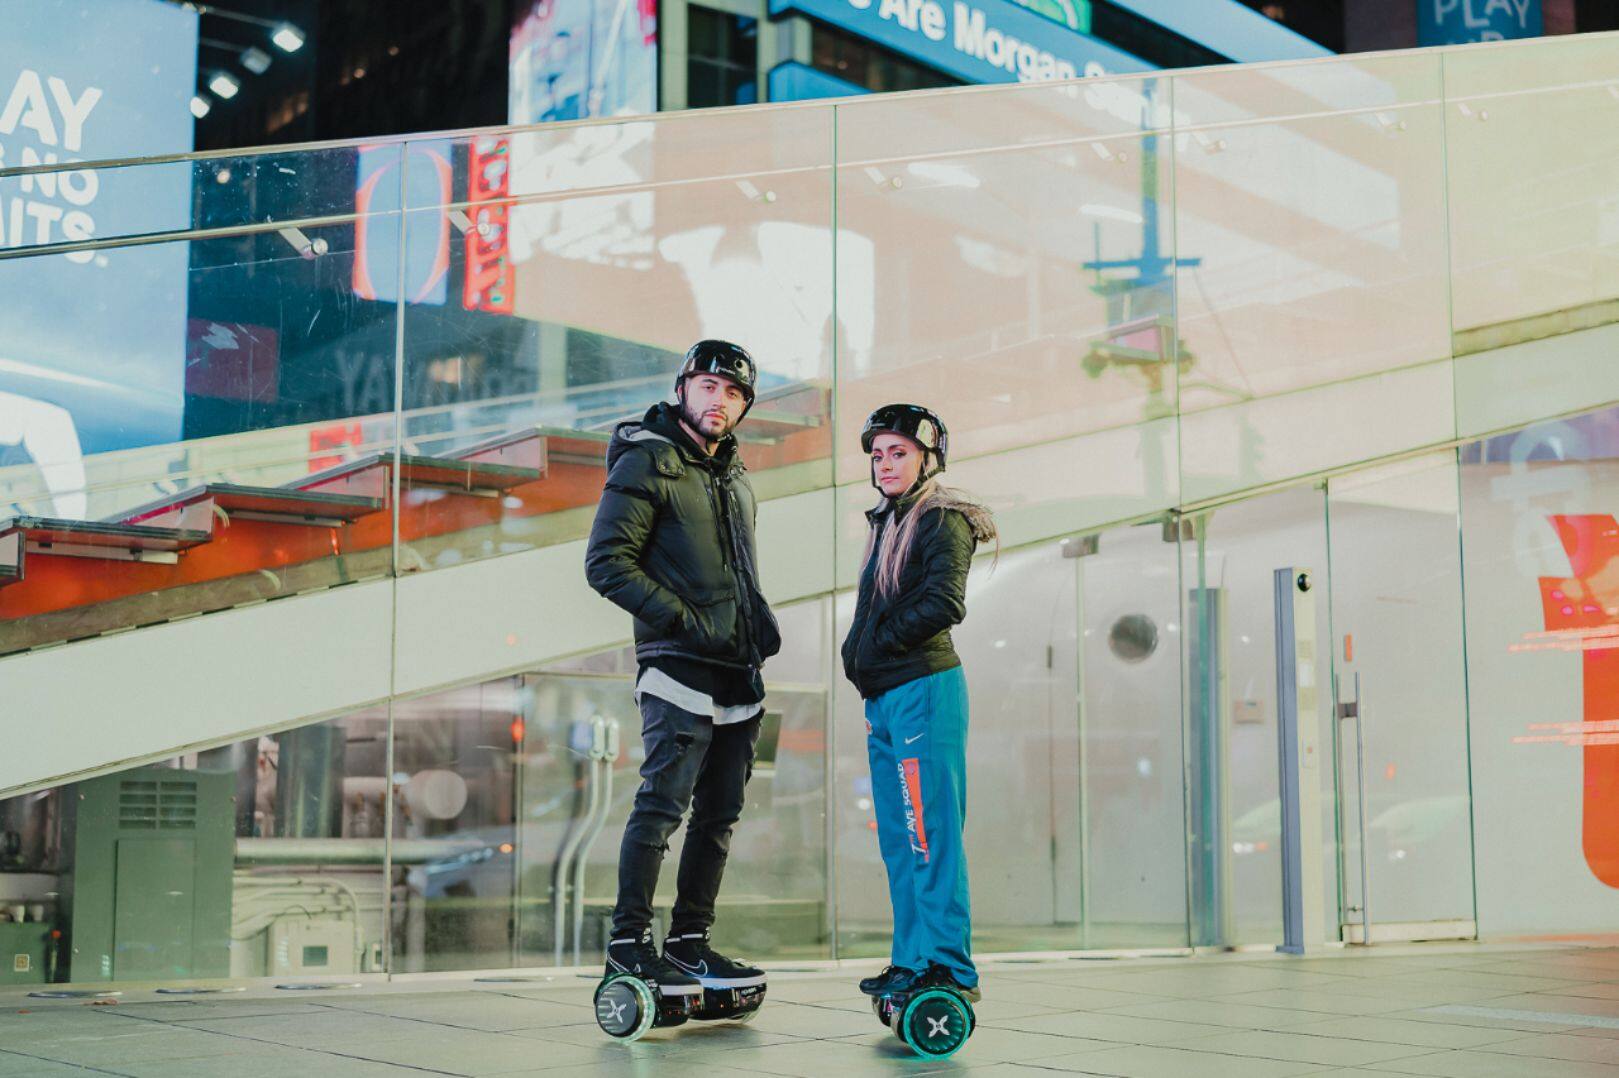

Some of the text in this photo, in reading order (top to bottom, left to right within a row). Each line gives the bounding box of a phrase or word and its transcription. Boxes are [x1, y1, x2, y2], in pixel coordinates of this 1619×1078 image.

[953, 4, 1077, 97] Morgan
[0, 194, 109, 268] ITS.
[897, 762, 911, 806] SQUAD
[906, 808, 917, 833] AVE
